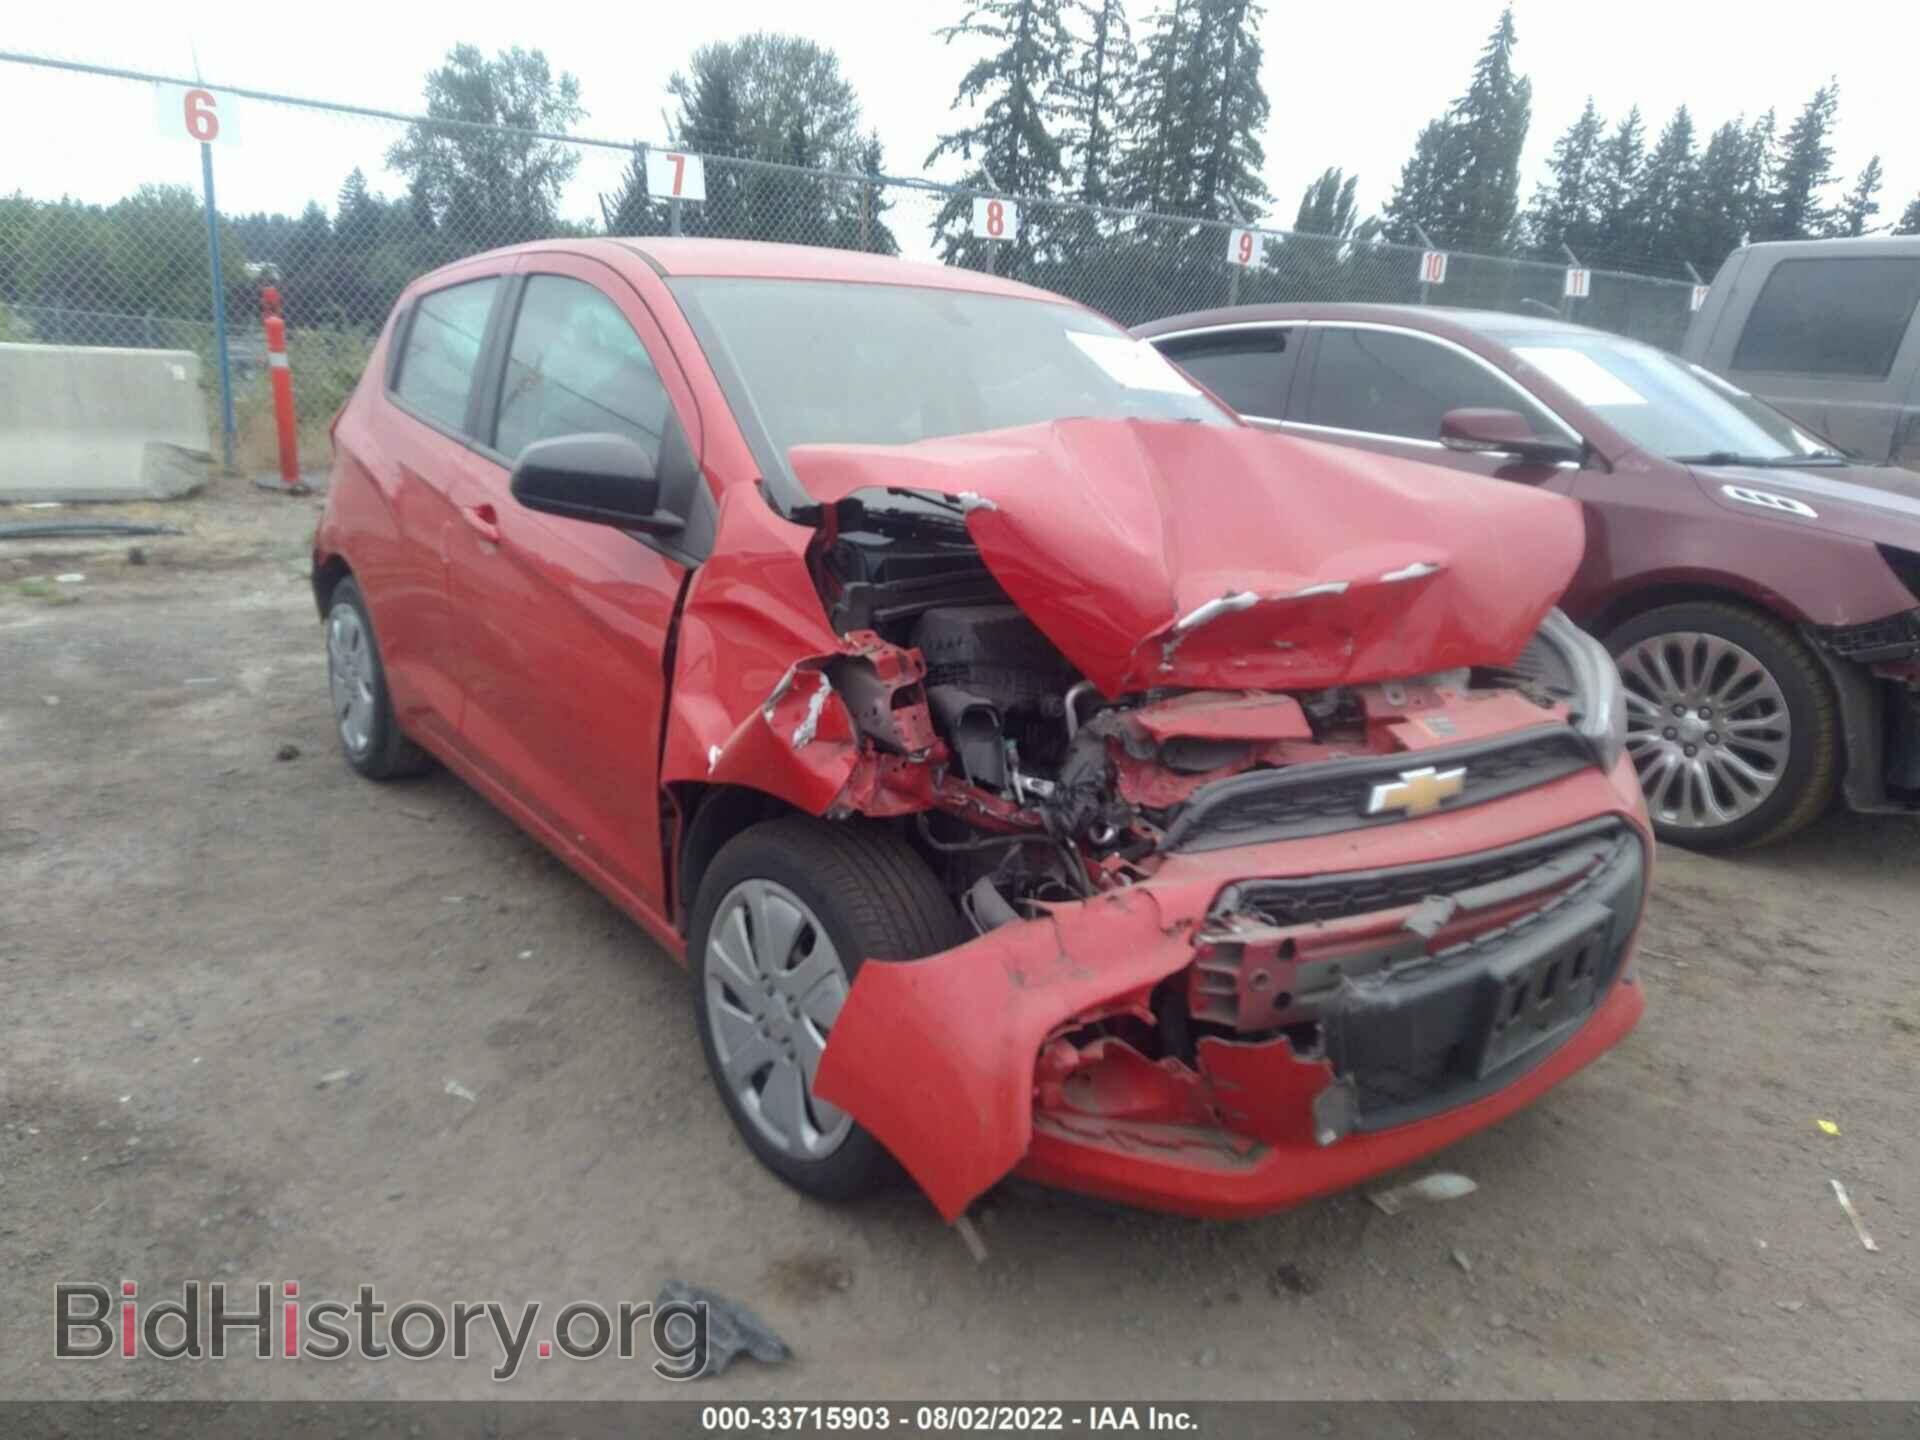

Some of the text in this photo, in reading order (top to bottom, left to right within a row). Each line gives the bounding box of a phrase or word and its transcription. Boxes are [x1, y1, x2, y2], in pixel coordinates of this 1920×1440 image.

[184, 90, 219, 141] 6
[666, 153, 686, 197] 7
[986, 200, 1004, 236] 8
[1237, 231, 1253, 264] 9
[1426, 253, 1442, 282] 10
[1571, 271, 1585, 297] 11
